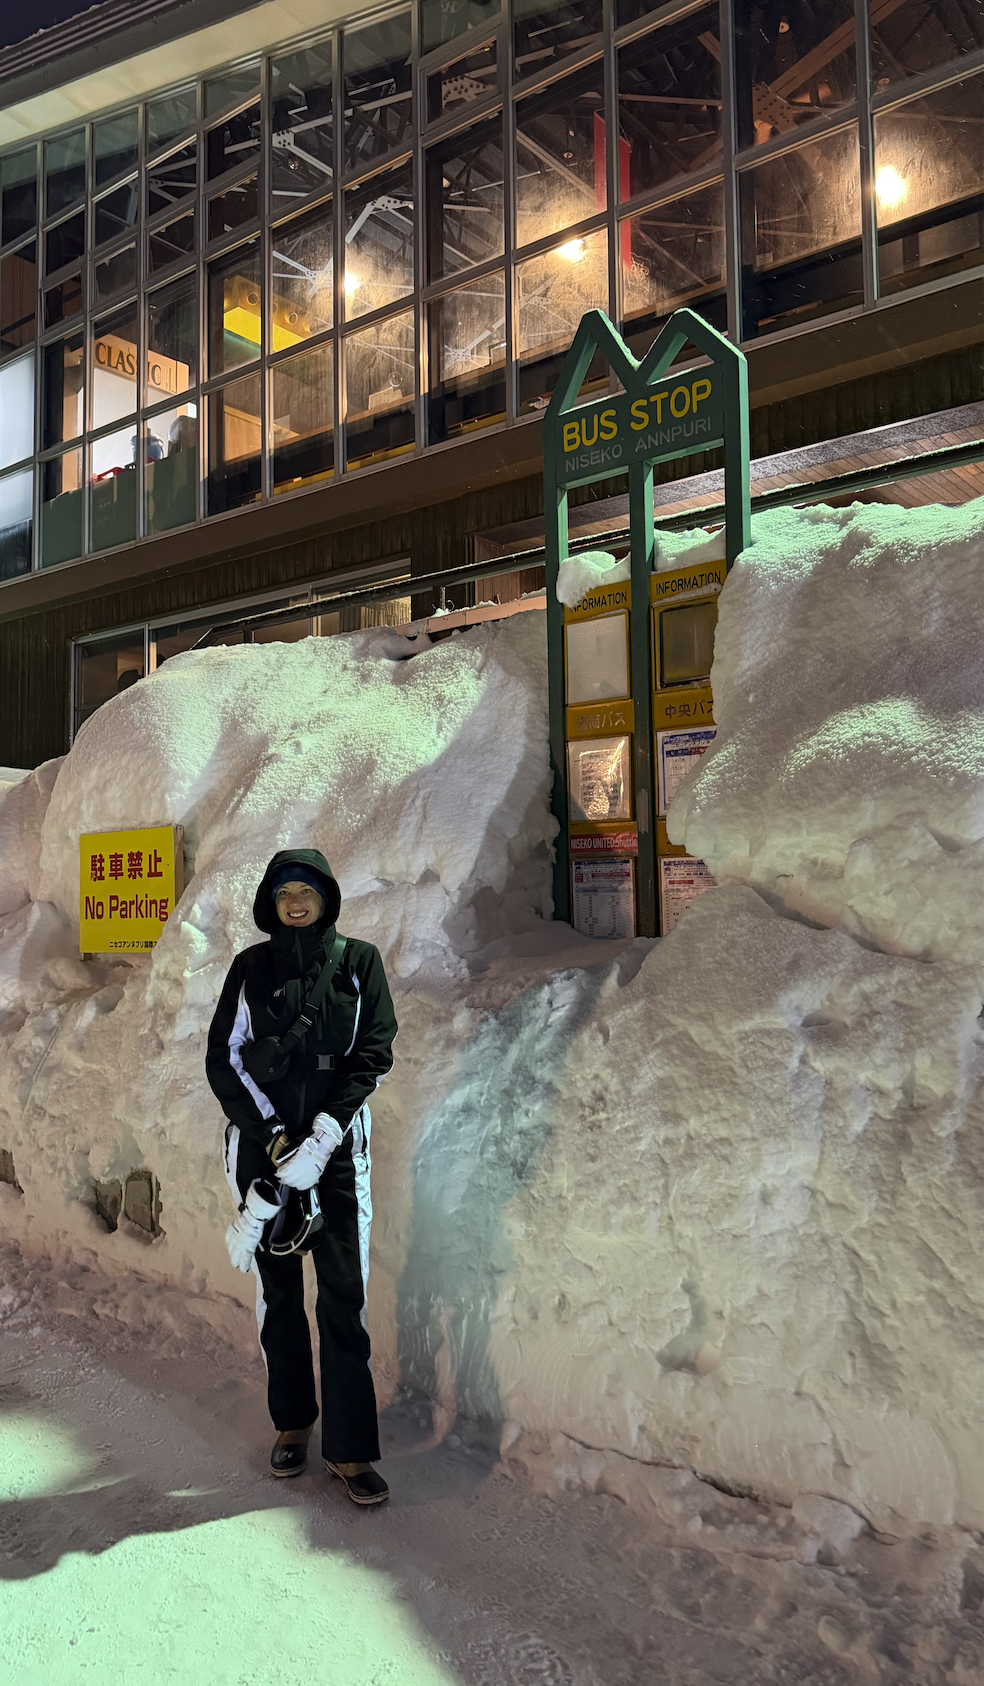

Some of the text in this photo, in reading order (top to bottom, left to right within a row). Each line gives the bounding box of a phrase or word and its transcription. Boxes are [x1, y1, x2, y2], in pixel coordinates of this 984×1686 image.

[95, 342, 161, 385] CLASIC
[563, 378, 712, 453] BUS STOP
[565, 416, 711, 473] NISEKO ANNPURI
[656, 571, 722, 595] INFORMATION
[570, 838, 592, 849] NISEKO
[593, 836, 614, 848] UNITED
[90, 849, 163, 882] 駐車禁止
[85, 893, 169, 922] No Parking
